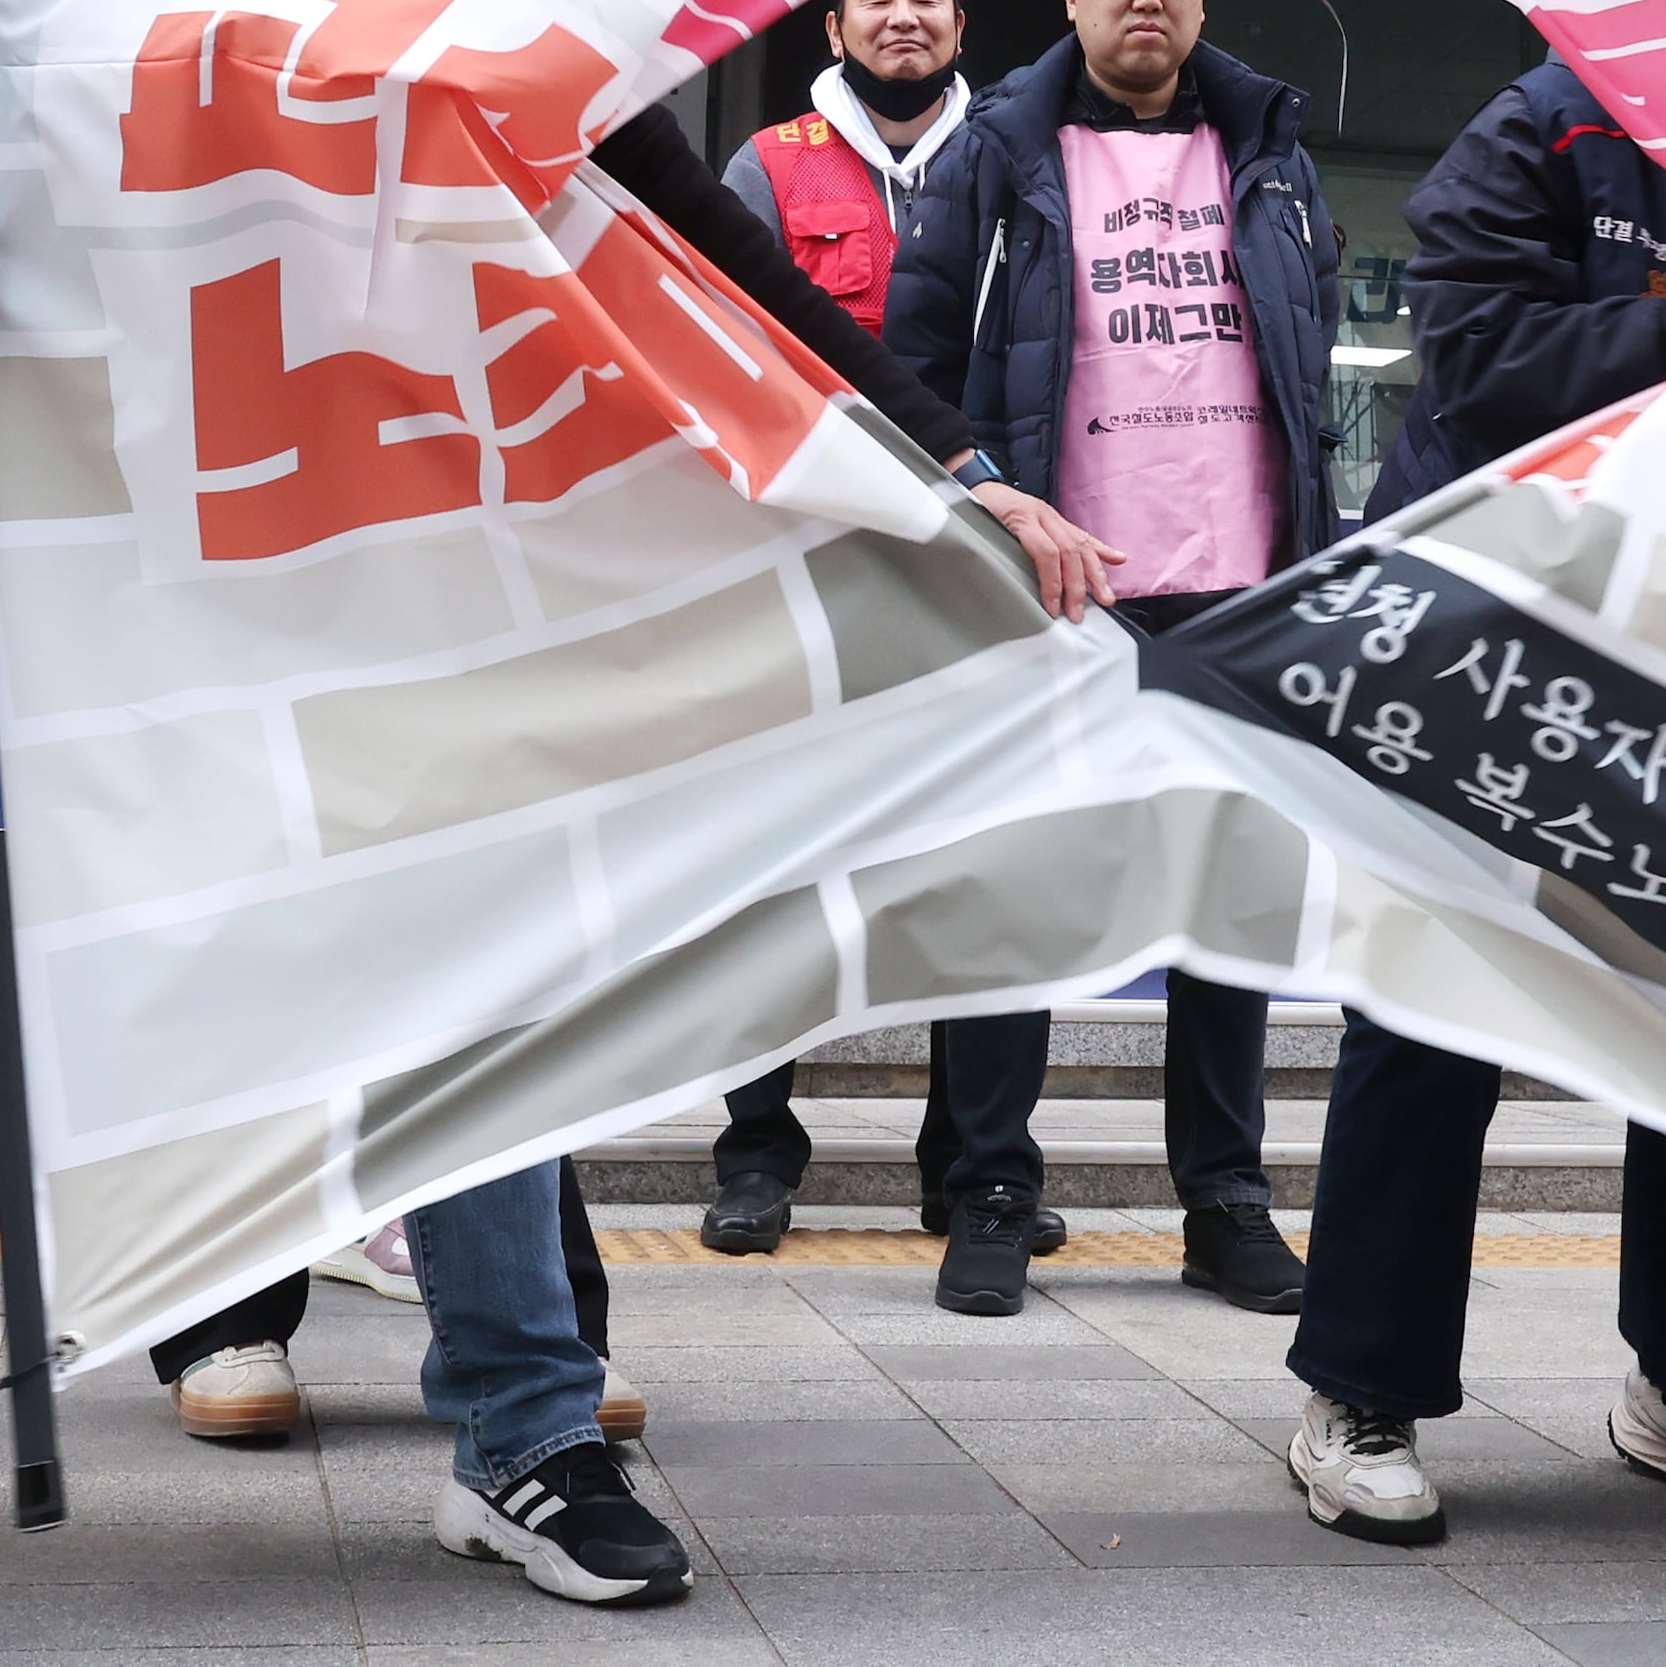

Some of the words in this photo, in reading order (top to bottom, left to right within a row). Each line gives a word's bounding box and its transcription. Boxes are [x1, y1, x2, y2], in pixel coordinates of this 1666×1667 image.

[775, 118, 831, 146] 단결
[1103, 196, 1174, 233] 비정규직
[1176, 203, 1226, 232] 철폐
[1593, 215, 1634, 244] 단결
[1278, 661, 1434, 776] 어용
